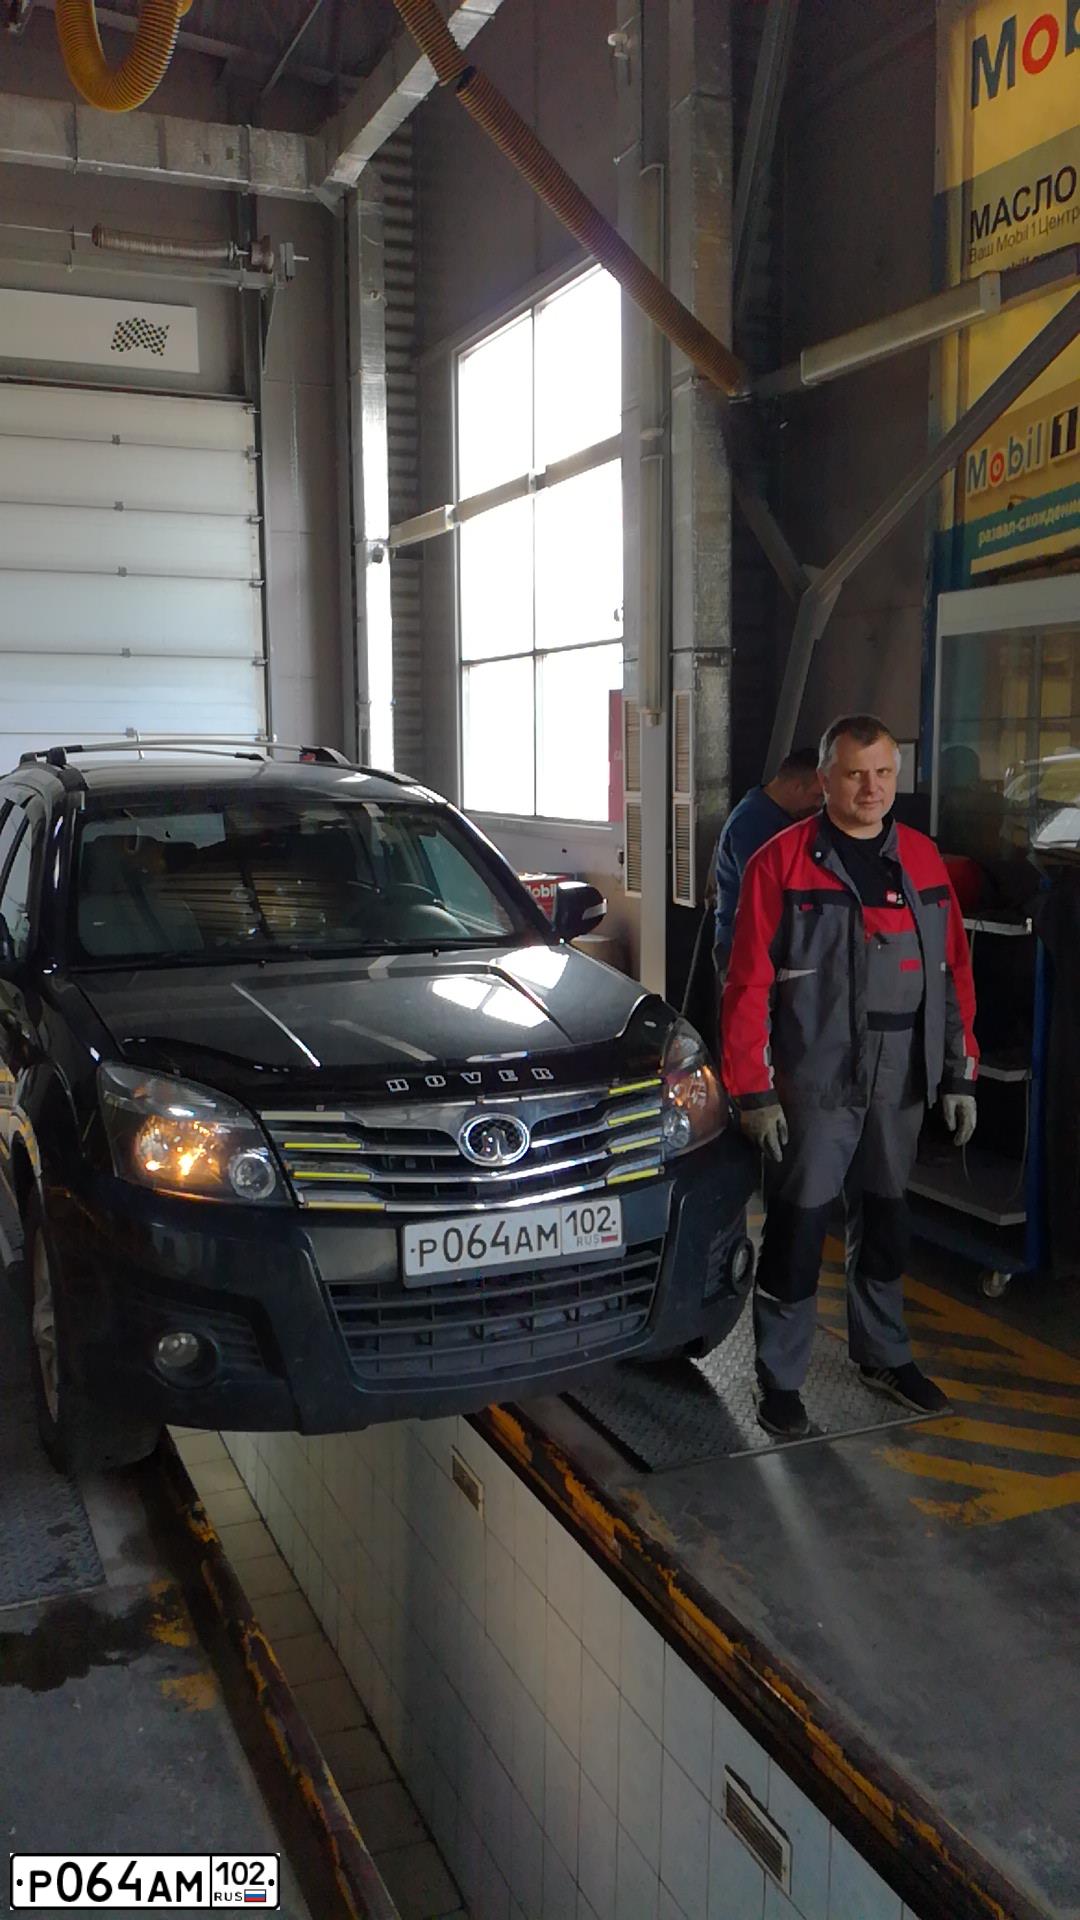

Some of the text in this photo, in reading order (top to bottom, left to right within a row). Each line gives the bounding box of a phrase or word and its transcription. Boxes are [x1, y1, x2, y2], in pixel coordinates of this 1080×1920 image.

[969, 166, 1077, 243] МАСЛО
[970, 242, 994, 264] Ваш
[996, 225, 1029, 254] Mobil
[967, 422, 1042, 492] Mobil
[386, 1067, 554, 1092] HOVER
[418, 1205, 612, 1267] Р064АМ 102
[576, 1235, 600, 1248] RUS
